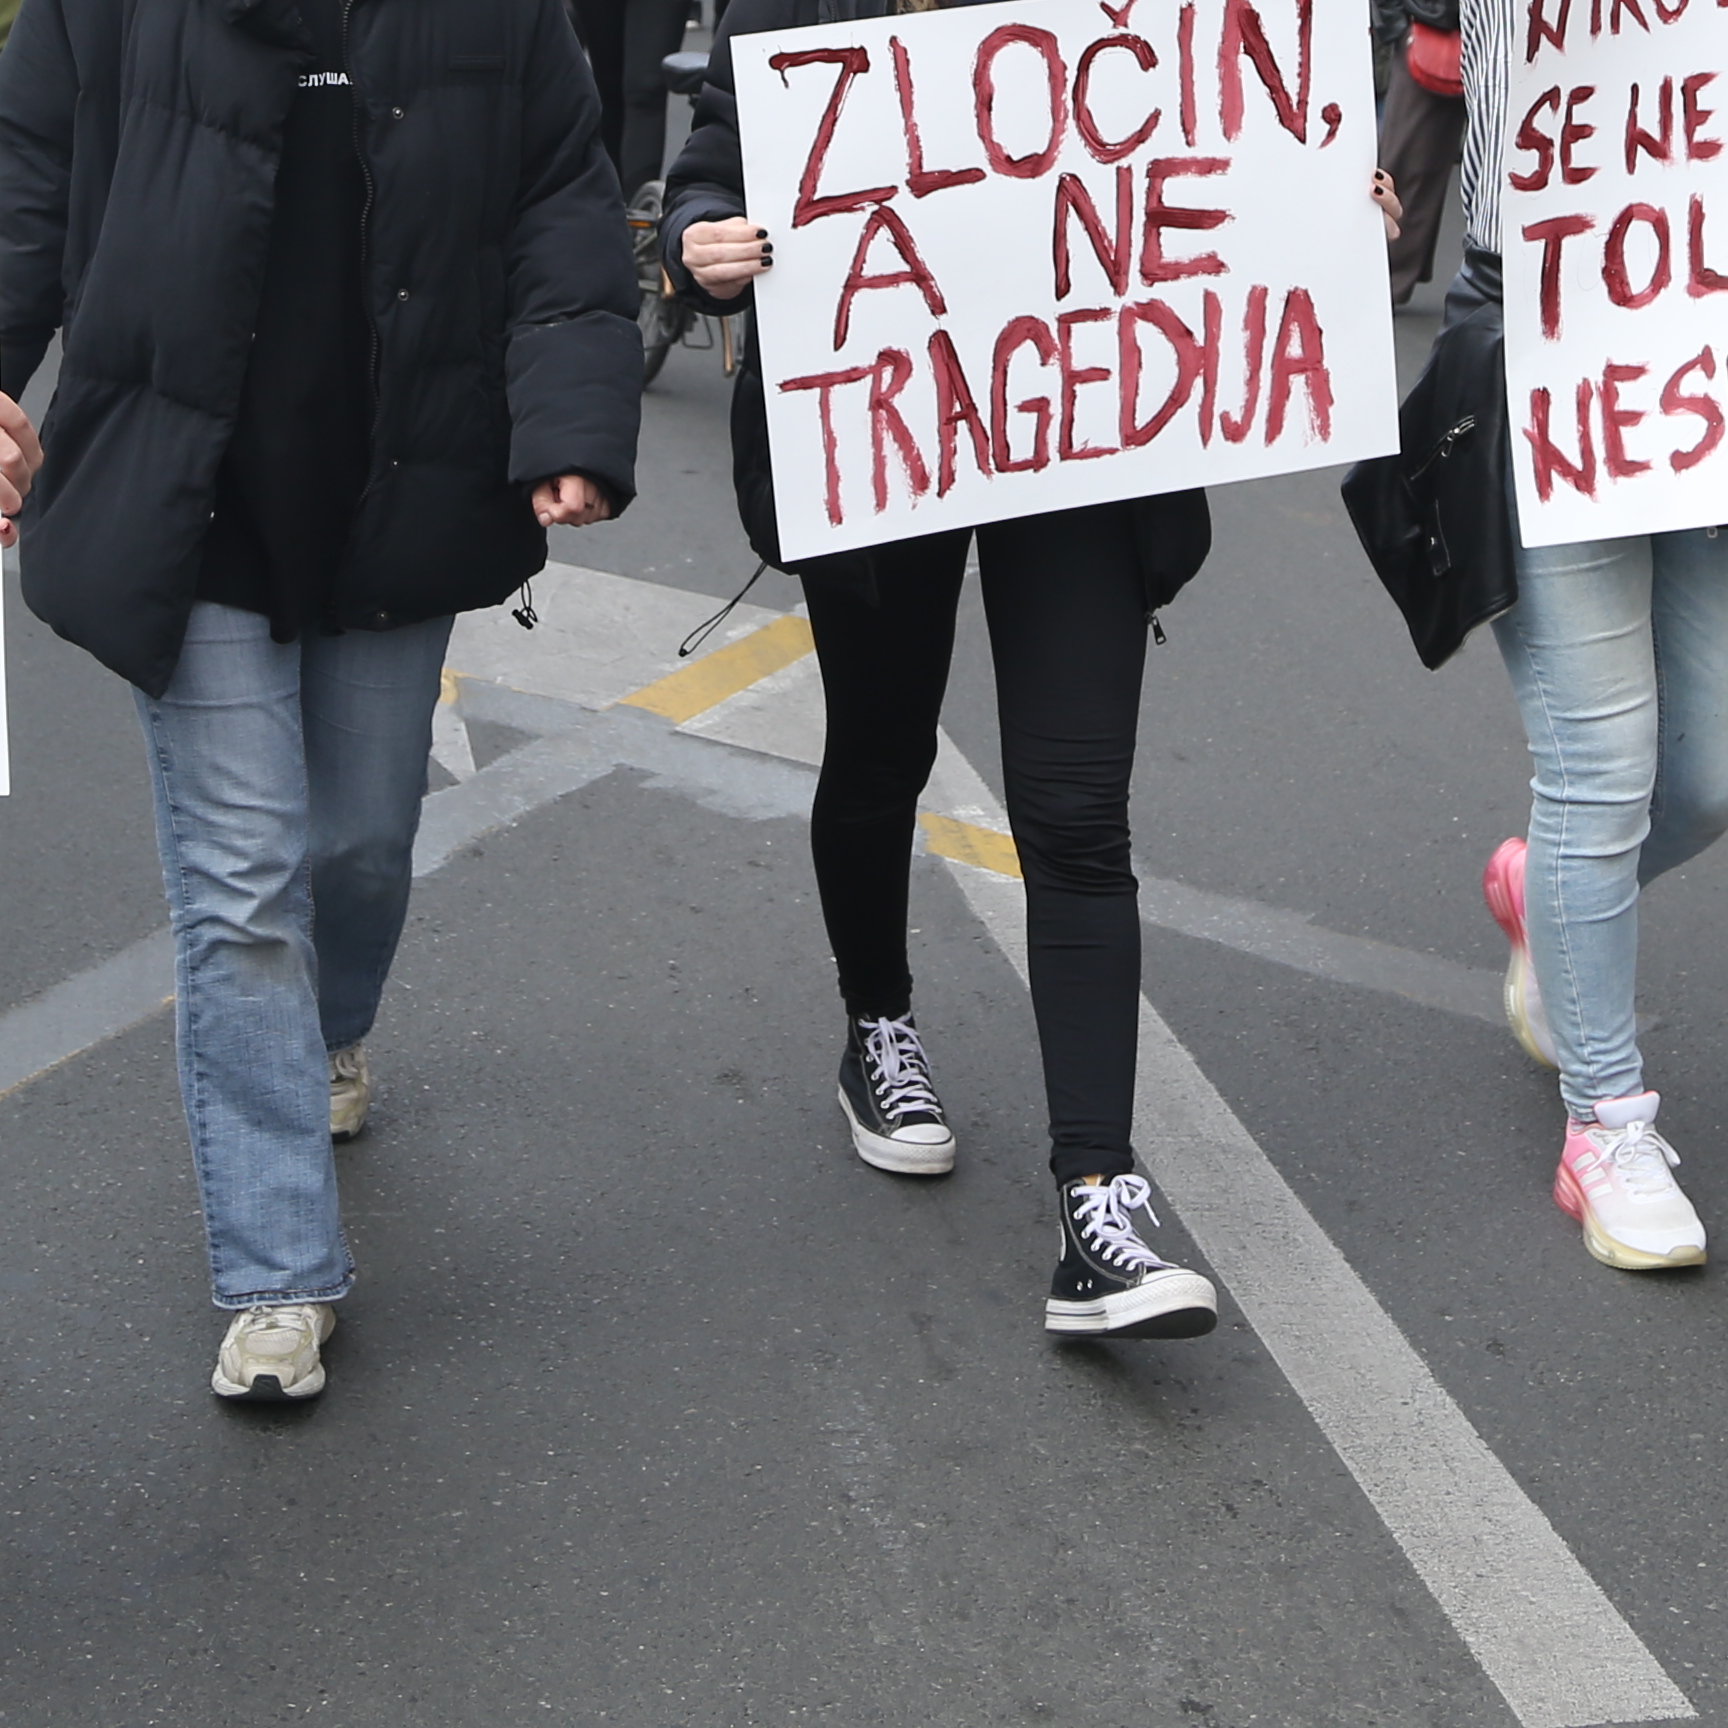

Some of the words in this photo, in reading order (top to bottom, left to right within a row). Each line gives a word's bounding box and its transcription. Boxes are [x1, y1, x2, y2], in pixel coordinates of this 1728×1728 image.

[1508, 85, 1600, 193] SE
[1623, 72, 1727, 176] NE
[833, 202, 947, 351] A
[1052, 156, 1236, 301] NE
[776, 284, 1335, 526] TRAGEDIJA
